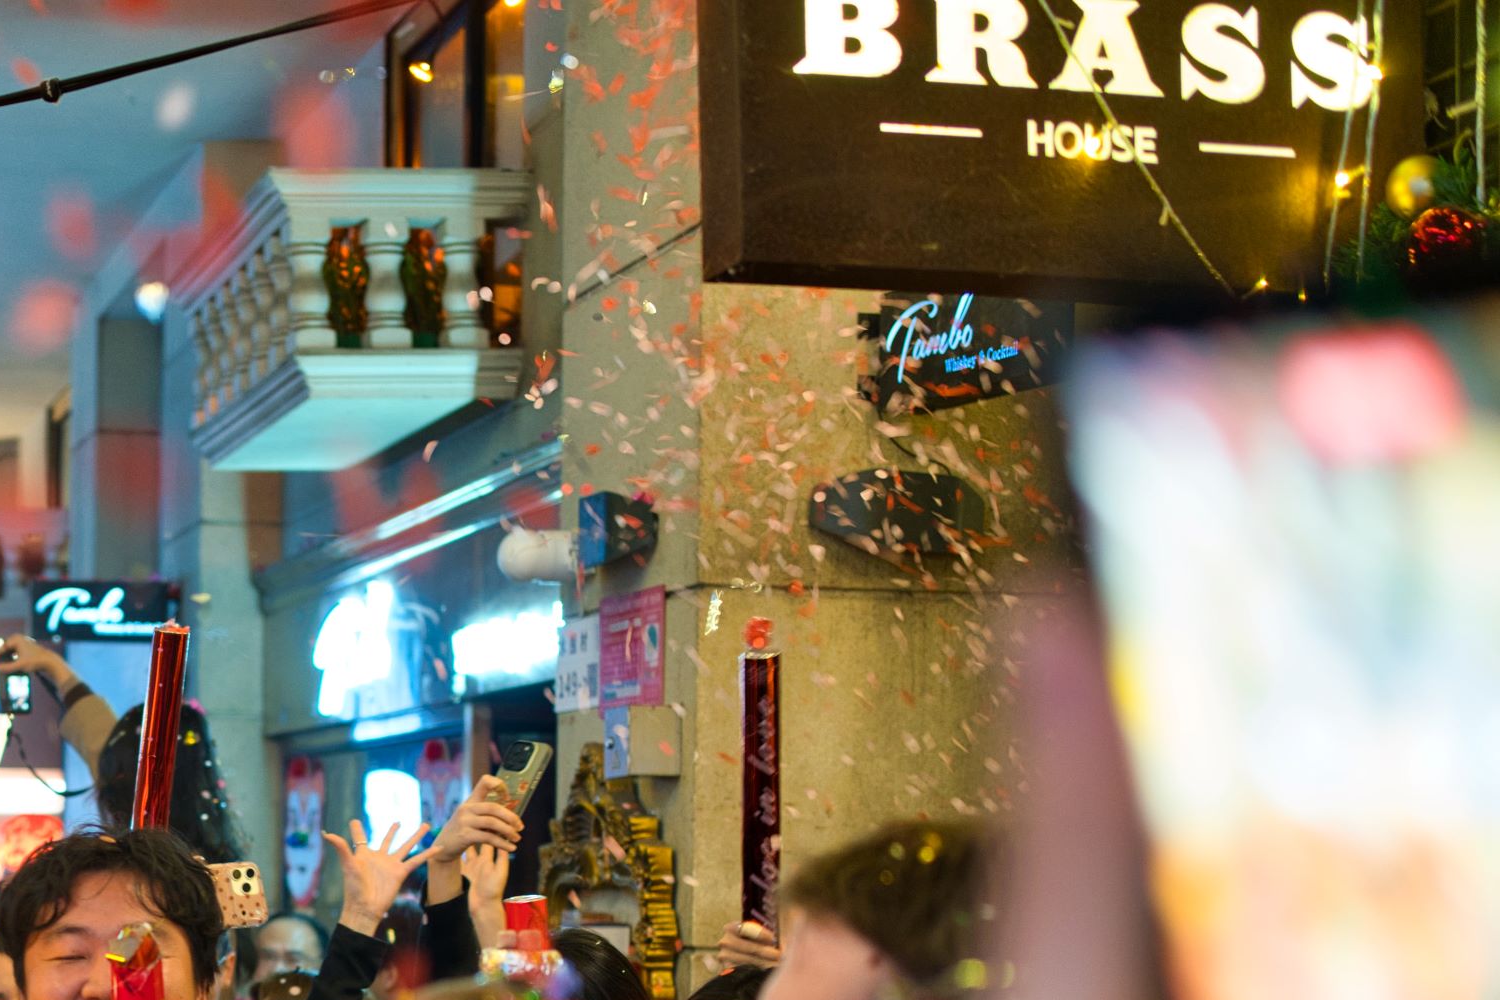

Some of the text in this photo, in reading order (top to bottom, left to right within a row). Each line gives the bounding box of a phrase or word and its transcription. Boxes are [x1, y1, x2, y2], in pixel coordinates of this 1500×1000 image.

[792, 0, 1379, 112] BRASS
[1027, 119, 1159, 165] HOUSE
[885, 292, 975, 384] Tambo
[945, 355, 977, 372] Whiskey
[987, 341, 1018, 361] Cocktail
